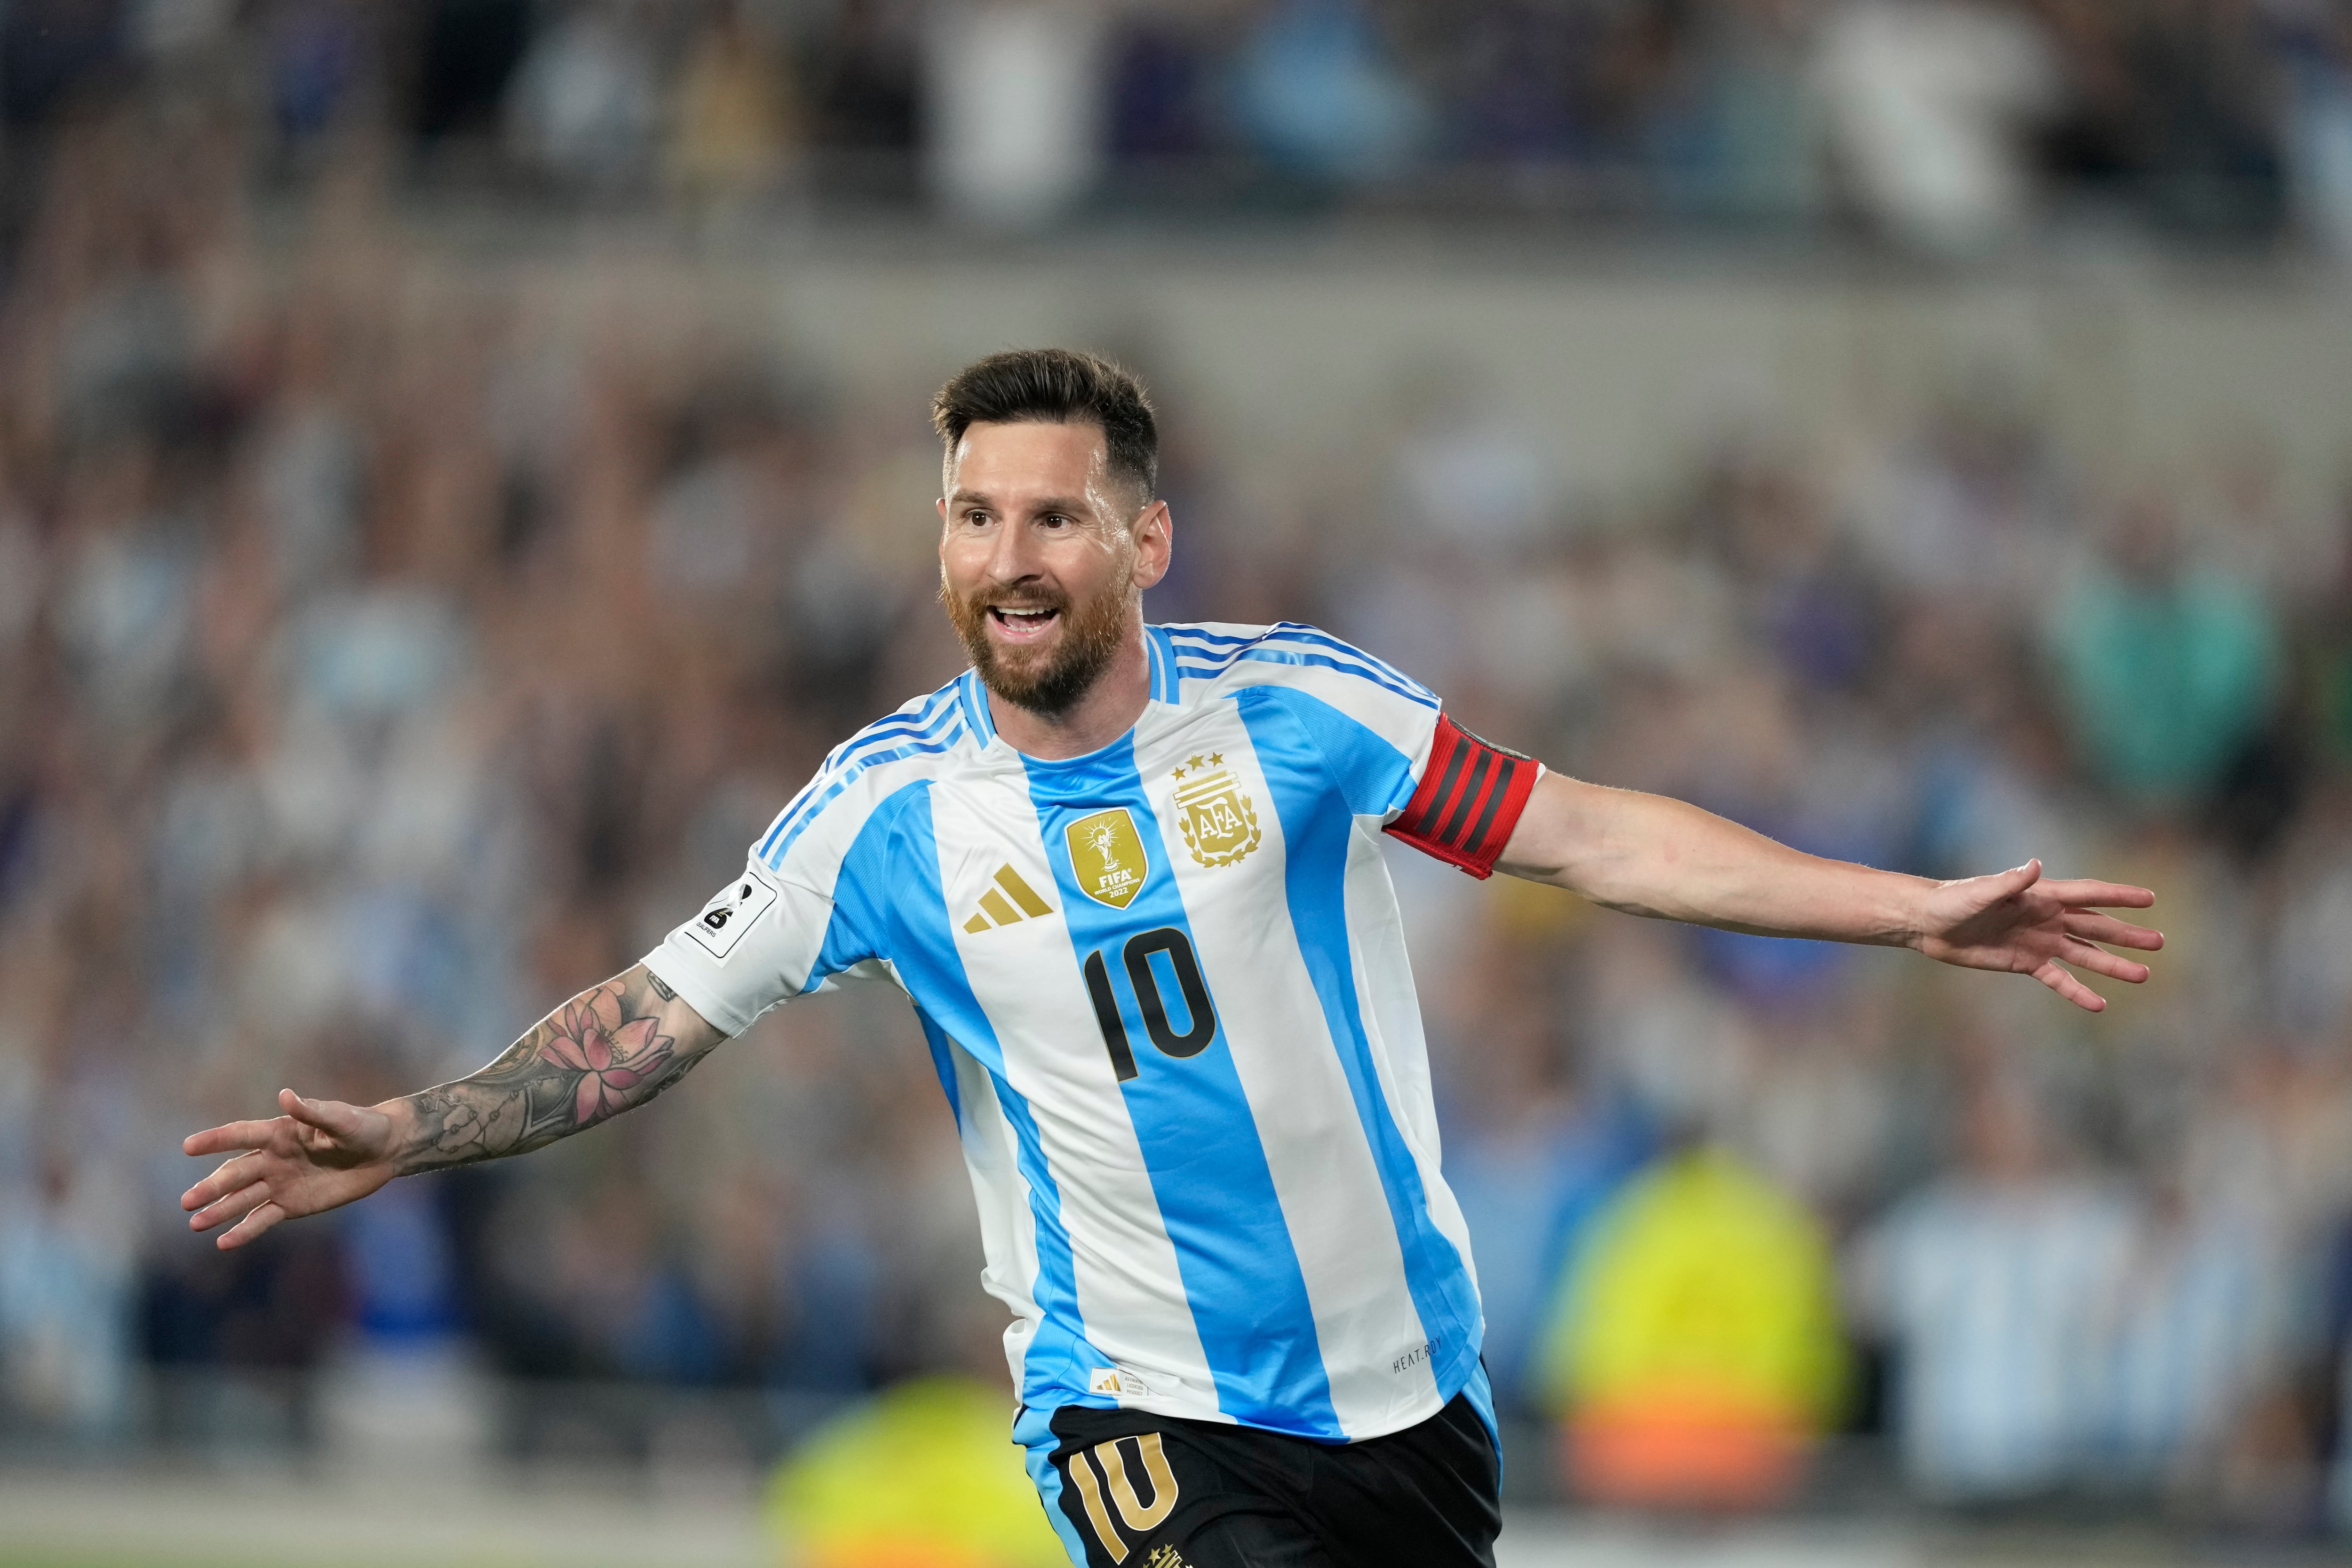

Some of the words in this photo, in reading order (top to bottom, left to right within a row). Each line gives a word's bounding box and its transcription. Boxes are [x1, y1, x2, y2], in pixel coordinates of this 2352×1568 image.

[1196, 797, 1242, 839] AFA
[1094, 887, 1112, 895] WORLD
[1112, 878, 1140, 889] CHAMPIONS
[1109, 887, 1128, 898] 2022
[696, 922, 716, 937] QUALIFIERS
[709, 915, 720, 924] FIFA
[1083, 926, 1217, 1083] 10
[1393, 1335, 1441, 1374] HEAT.RDY
[1069, 1432, 1179, 1565] 10
